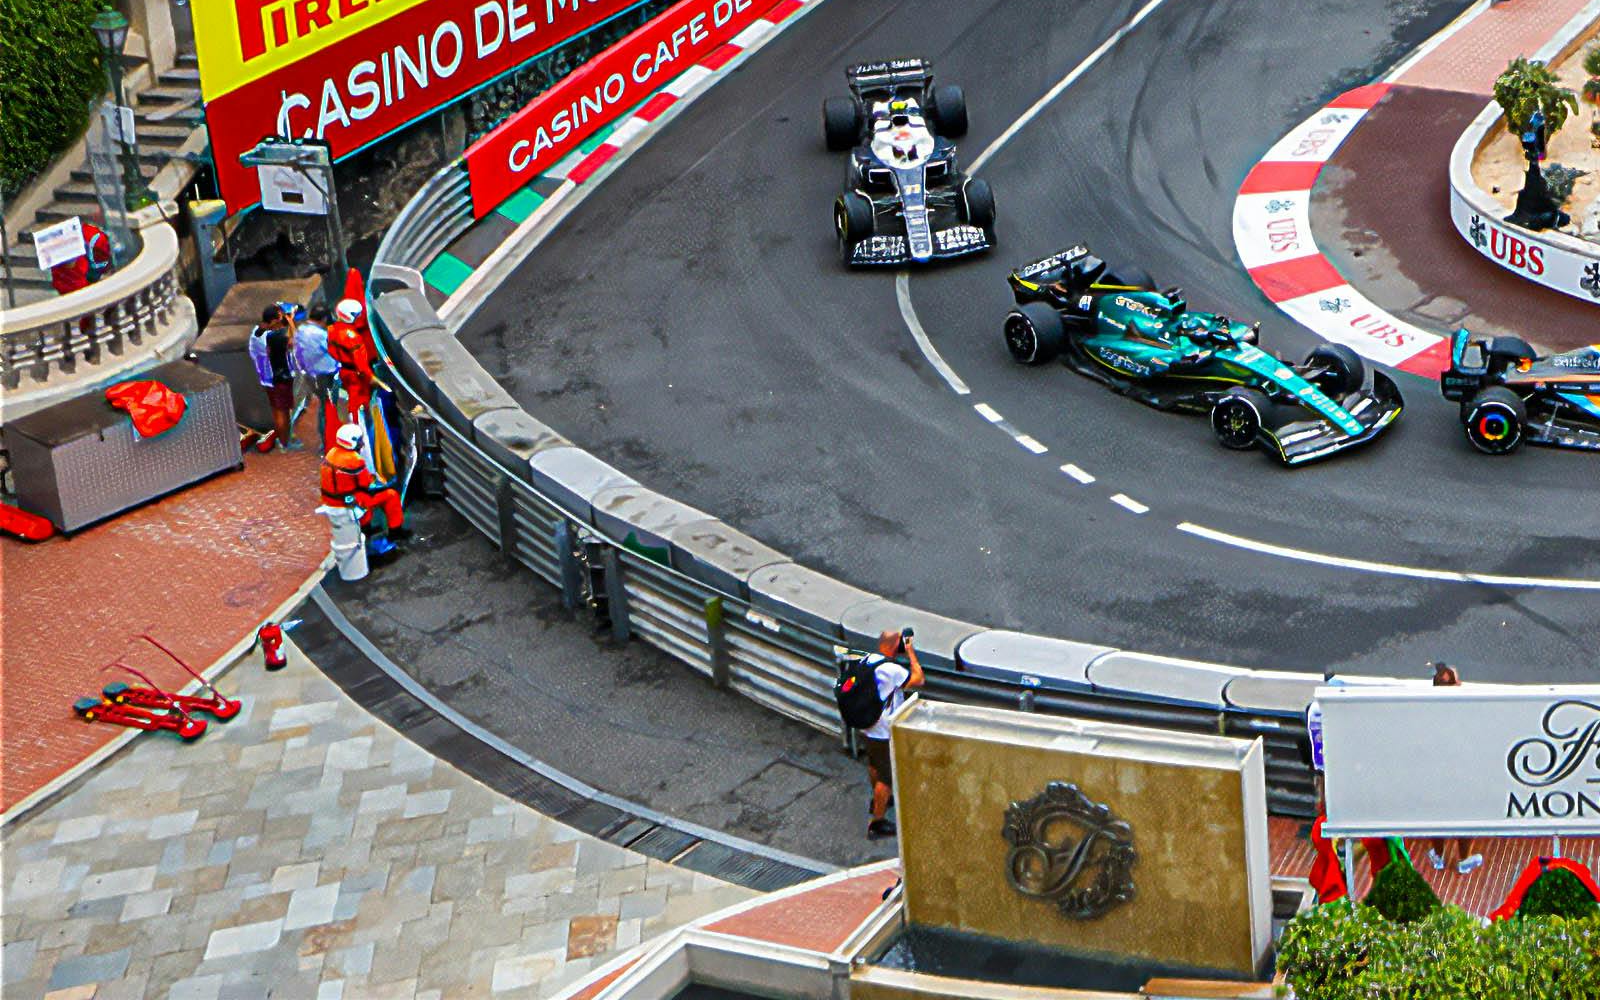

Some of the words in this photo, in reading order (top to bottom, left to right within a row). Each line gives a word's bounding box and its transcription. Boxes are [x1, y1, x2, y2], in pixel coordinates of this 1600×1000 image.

[276, 35, 464, 141] CASINO
[507, 78, 626, 175] CASINO
[631, 19, 709, 86] CAFE
[1291, 128, 1337, 159] UBS
[1266, 217, 1300, 255] UBS
[1488, 228, 1546, 278] UBS
[1349, 312, 1416, 350] UBS
